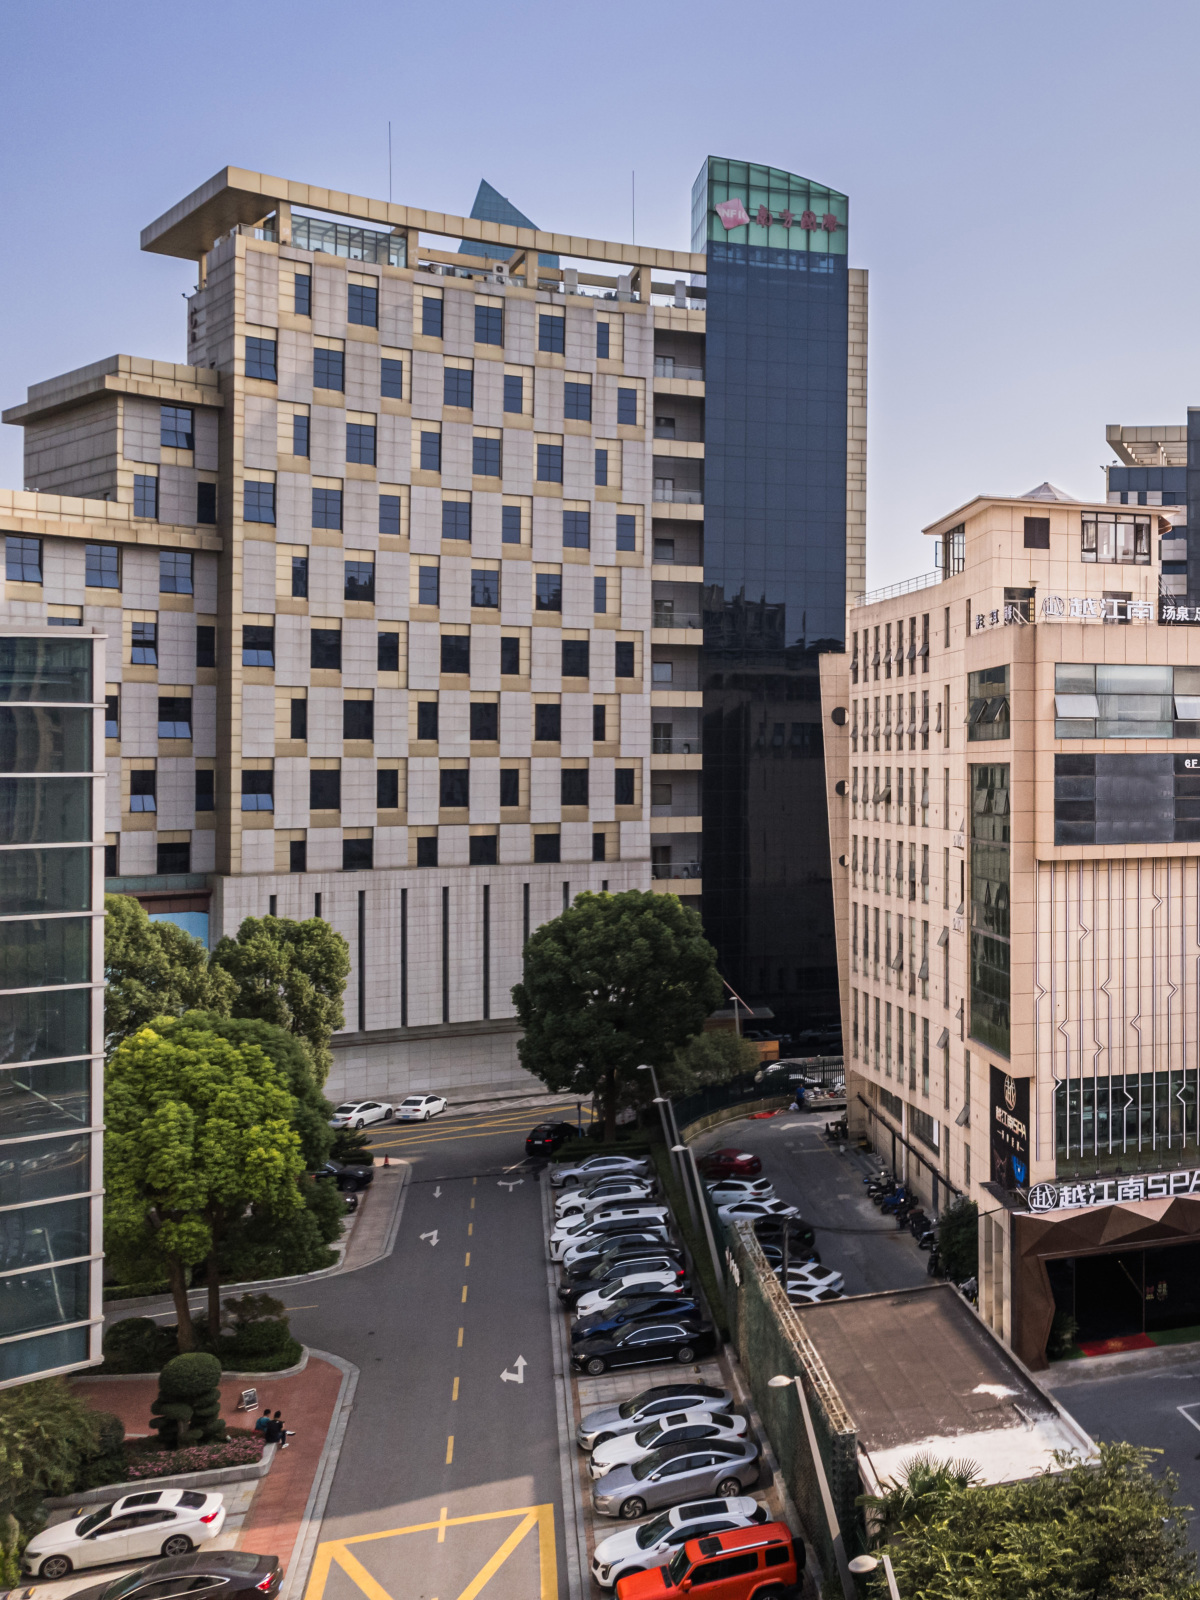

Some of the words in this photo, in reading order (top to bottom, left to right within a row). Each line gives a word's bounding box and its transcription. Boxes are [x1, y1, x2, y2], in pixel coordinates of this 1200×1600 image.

[1069, 597, 1154, 621] 越江南
[1184, 758, 1199, 768] 6F
